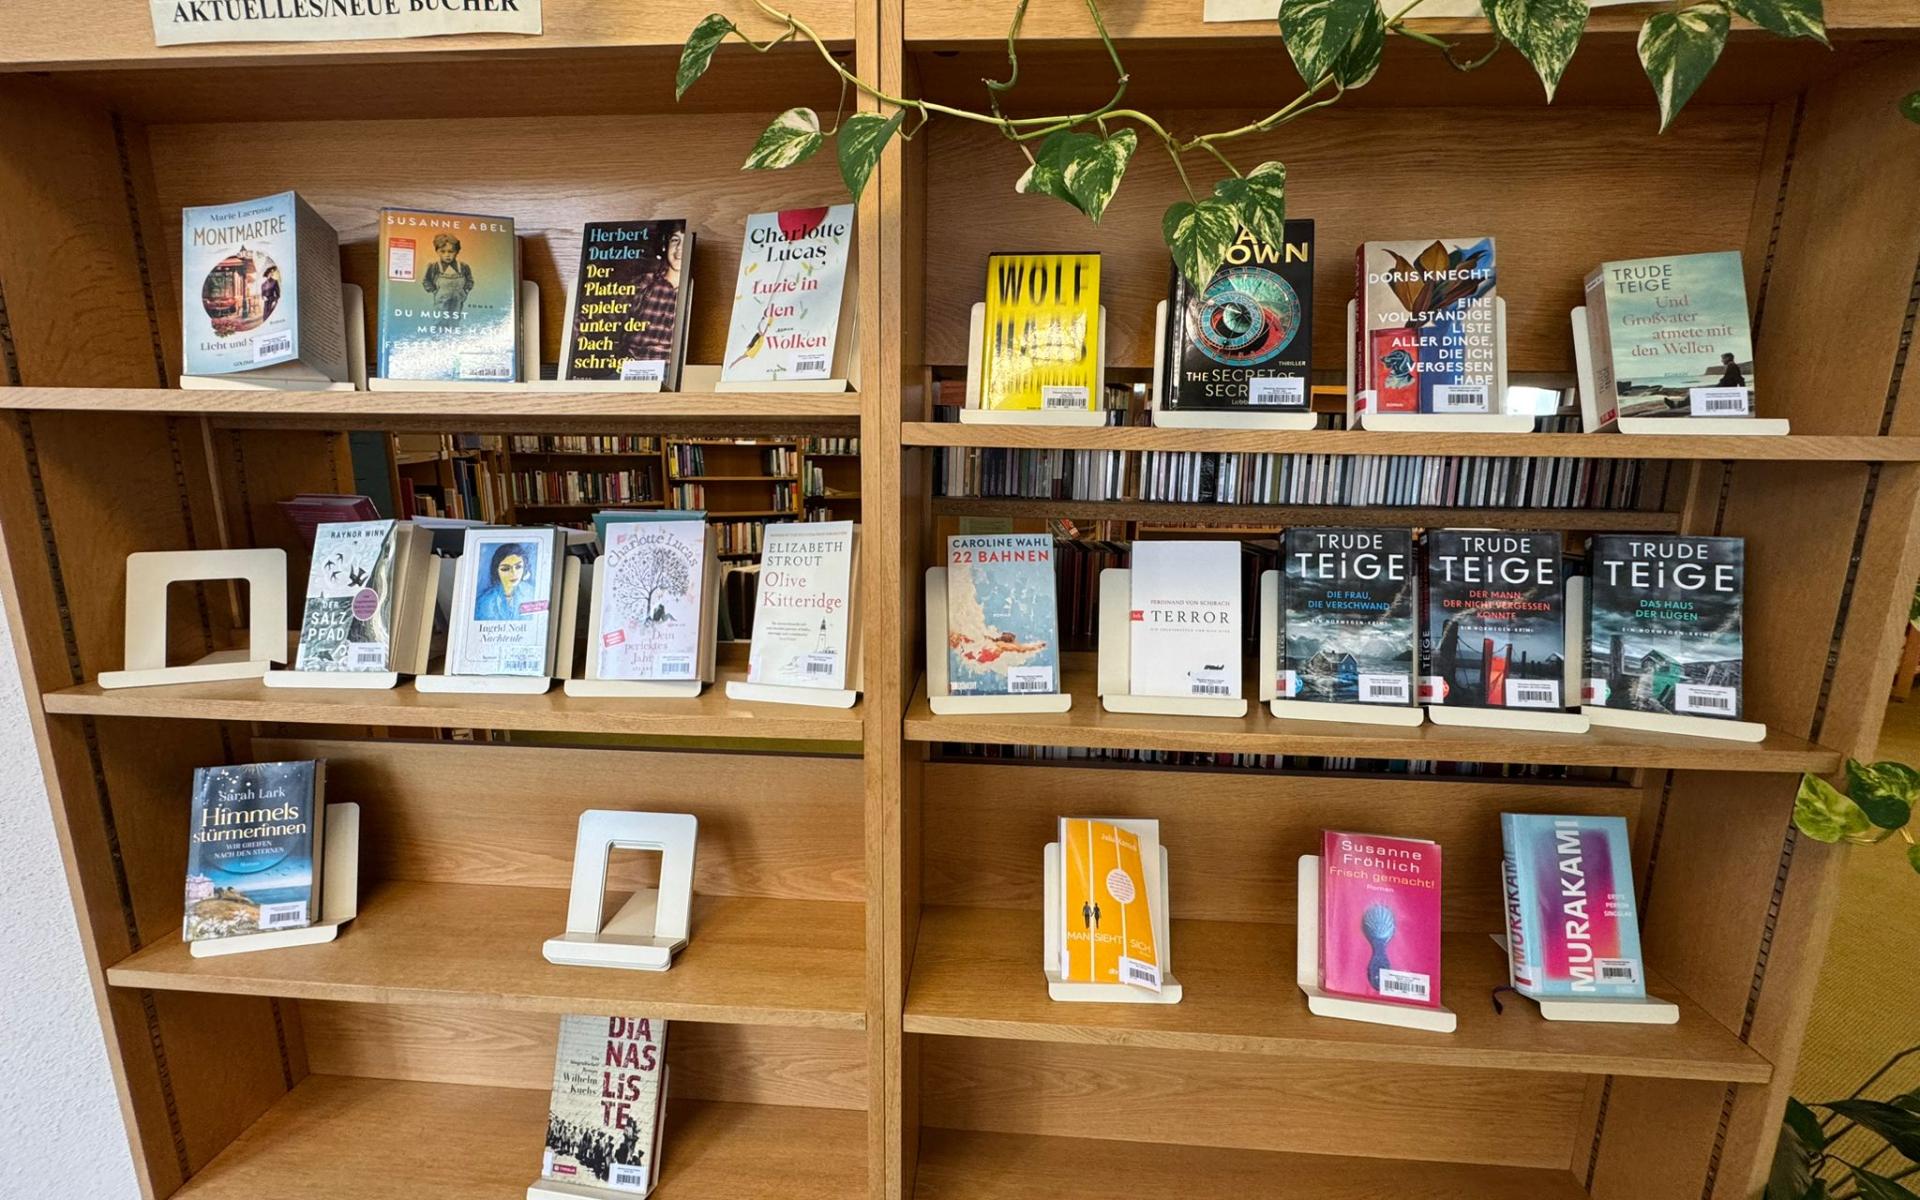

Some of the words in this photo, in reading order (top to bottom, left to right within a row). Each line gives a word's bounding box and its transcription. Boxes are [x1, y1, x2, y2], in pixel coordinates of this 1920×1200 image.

[210, 212, 237, 222] Marie
[238, 205, 274, 219] Lacrosse
[193, 214, 287, 247] MONTMARTRE
[387, 215, 461, 230] SUSANNE
[469, 223, 507, 233] ABEL
[590, 227, 649, 242] Herbert
[750, 221, 845, 245] Charlotte
[589, 246, 645, 260] Dutzler
[767, 245, 827, 263] Lucas
[1222, 243, 1308, 265] OWN
[586, 264, 614, 278] Der
[1369, 271, 1419, 284] DORIS
[1424, 268, 1491, 281] KNECHT
[1613, 264, 1672, 281] TRUDE
[752, 278, 797, 295] Luzie
[801, 277, 818, 291] in
[998, 260, 1089, 305] WOLF
[1617, 278, 1671, 294] TEIGE
[1458, 298, 1492, 308] EINE
[1656, 294, 1689, 308] Und
[394, 308, 413, 318] DU
[421, 310, 469, 320] MUSST
[581, 300, 632, 319] spieler
[763, 302, 794, 318] den
[1378, 309, 1492, 322] VOLLSTÄNDIGE
[579, 320, 622, 333] unter
[624, 317, 650, 332] der
[1623, 311, 1698, 326] Großvater
[417, 325, 462, 335] MEINE
[468, 327, 499, 338] HAN
[1453, 323, 1492, 334] LISTE
[1652, 328, 1704, 340] atmete
[1707, 324, 1734, 336] mit
[200, 340, 226, 351] Licht
[230, 338, 247, 348] und
[766, 334, 827, 349] Wolken
[1392, 337, 1438, 347] ALLER
[1442, 336, 1493, 347] DINGE,
[1631, 344, 1659, 357] den
[1664, 341, 1714, 355] Wellen
[1439, 349, 1463, 359] DIE
[1468, 349, 1493, 359] ICH
[1407, 361, 1493, 372] VERGESSEN
[1186, 371, 1209, 382] THE
[1212, 369, 1275, 382] SECRET
[1454, 375, 1493, 385] HABE
[1205, 385, 1248, 397] SECR
[331, 530, 362, 539] RAYNOR
[365, 530, 385, 538] WINN
[1317, 534, 1383, 550] TRUDE
[607, 533, 665, 568] Charlotte
[664, 533, 699, 568] Lucas
[769, 541, 844, 554] ELIZABETH
[952, 538, 1013, 549] CAROLINE
[1015, 537, 1049, 547] WAHL
[1461, 536, 1531, 553] TRUDE
[1629, 542, 1708, 559] TRUDE
[767, 555, 823, 567] STROUT
[953, 551, 972, 563] 22
[978, 550, 1049, 562] BAHNEN
[1295, 552, 1404, 580] TEiGE
[1439, 556, 1553, 584] TEiGE
[765, 571, 807, 588] Olive
[1603, 561, 1734, 592] TEiGE
[1345, 591, 1371, 600] FRAU,
[1469, 590, 1487, 598] DER
[322, 601, 339, 609] DER
[763, 591, 843, 614] Kitteridge
[1326, 601, 1390, 611] VERSCHWAND
[1443, 599, 1461, 608] DER
[1465, 601, 1492, 609] NICHT
[1496, 602, 1550, 611] VERGESSEN
[1640, 600, 1661, 608] DAS
[1664, 601, 1693, 610] HAUS
[311, 612, 347, 625] SALZ
[1151, 610, 1230, 624] TERROR
[1635, 610, 1656, 618] DER
[1661, 610, 1698, 621] LÜGEN
[308, 628, 345, 641] PFAD
[479, 623, 506, 634] Ingrid
[219, 789, 255, 802] Sarah
[258, 787, 286, 799] Lark
[202, 802, 299, 827] Himmels
[193, 822, 307, 843] stürmerinnen
[242, 841, 272, 849] GREIFEN
[1341, 840, 1422, 861] Susanne
[214, 851, 235, 859] NACH
[236, 849, 251, 857] DEN
[253, 847, 284, 855] STERNEN
[1343, 854, 1420, 874] Fröhlich
[1330, 866, 1368, 880] Frisch
[1372, 872, 1435, 889] gemacht!
[1554, 820, 1596, 992] MURAKAMI
[1068, 931, 1090, 941] MAN
[1094, 932, 1122, 944] SIEHT
[1130, 940, 1151, 953] SICH
[605, 1040, 657, 1071] NAS
[601, 1100, 631, 1130] TE
